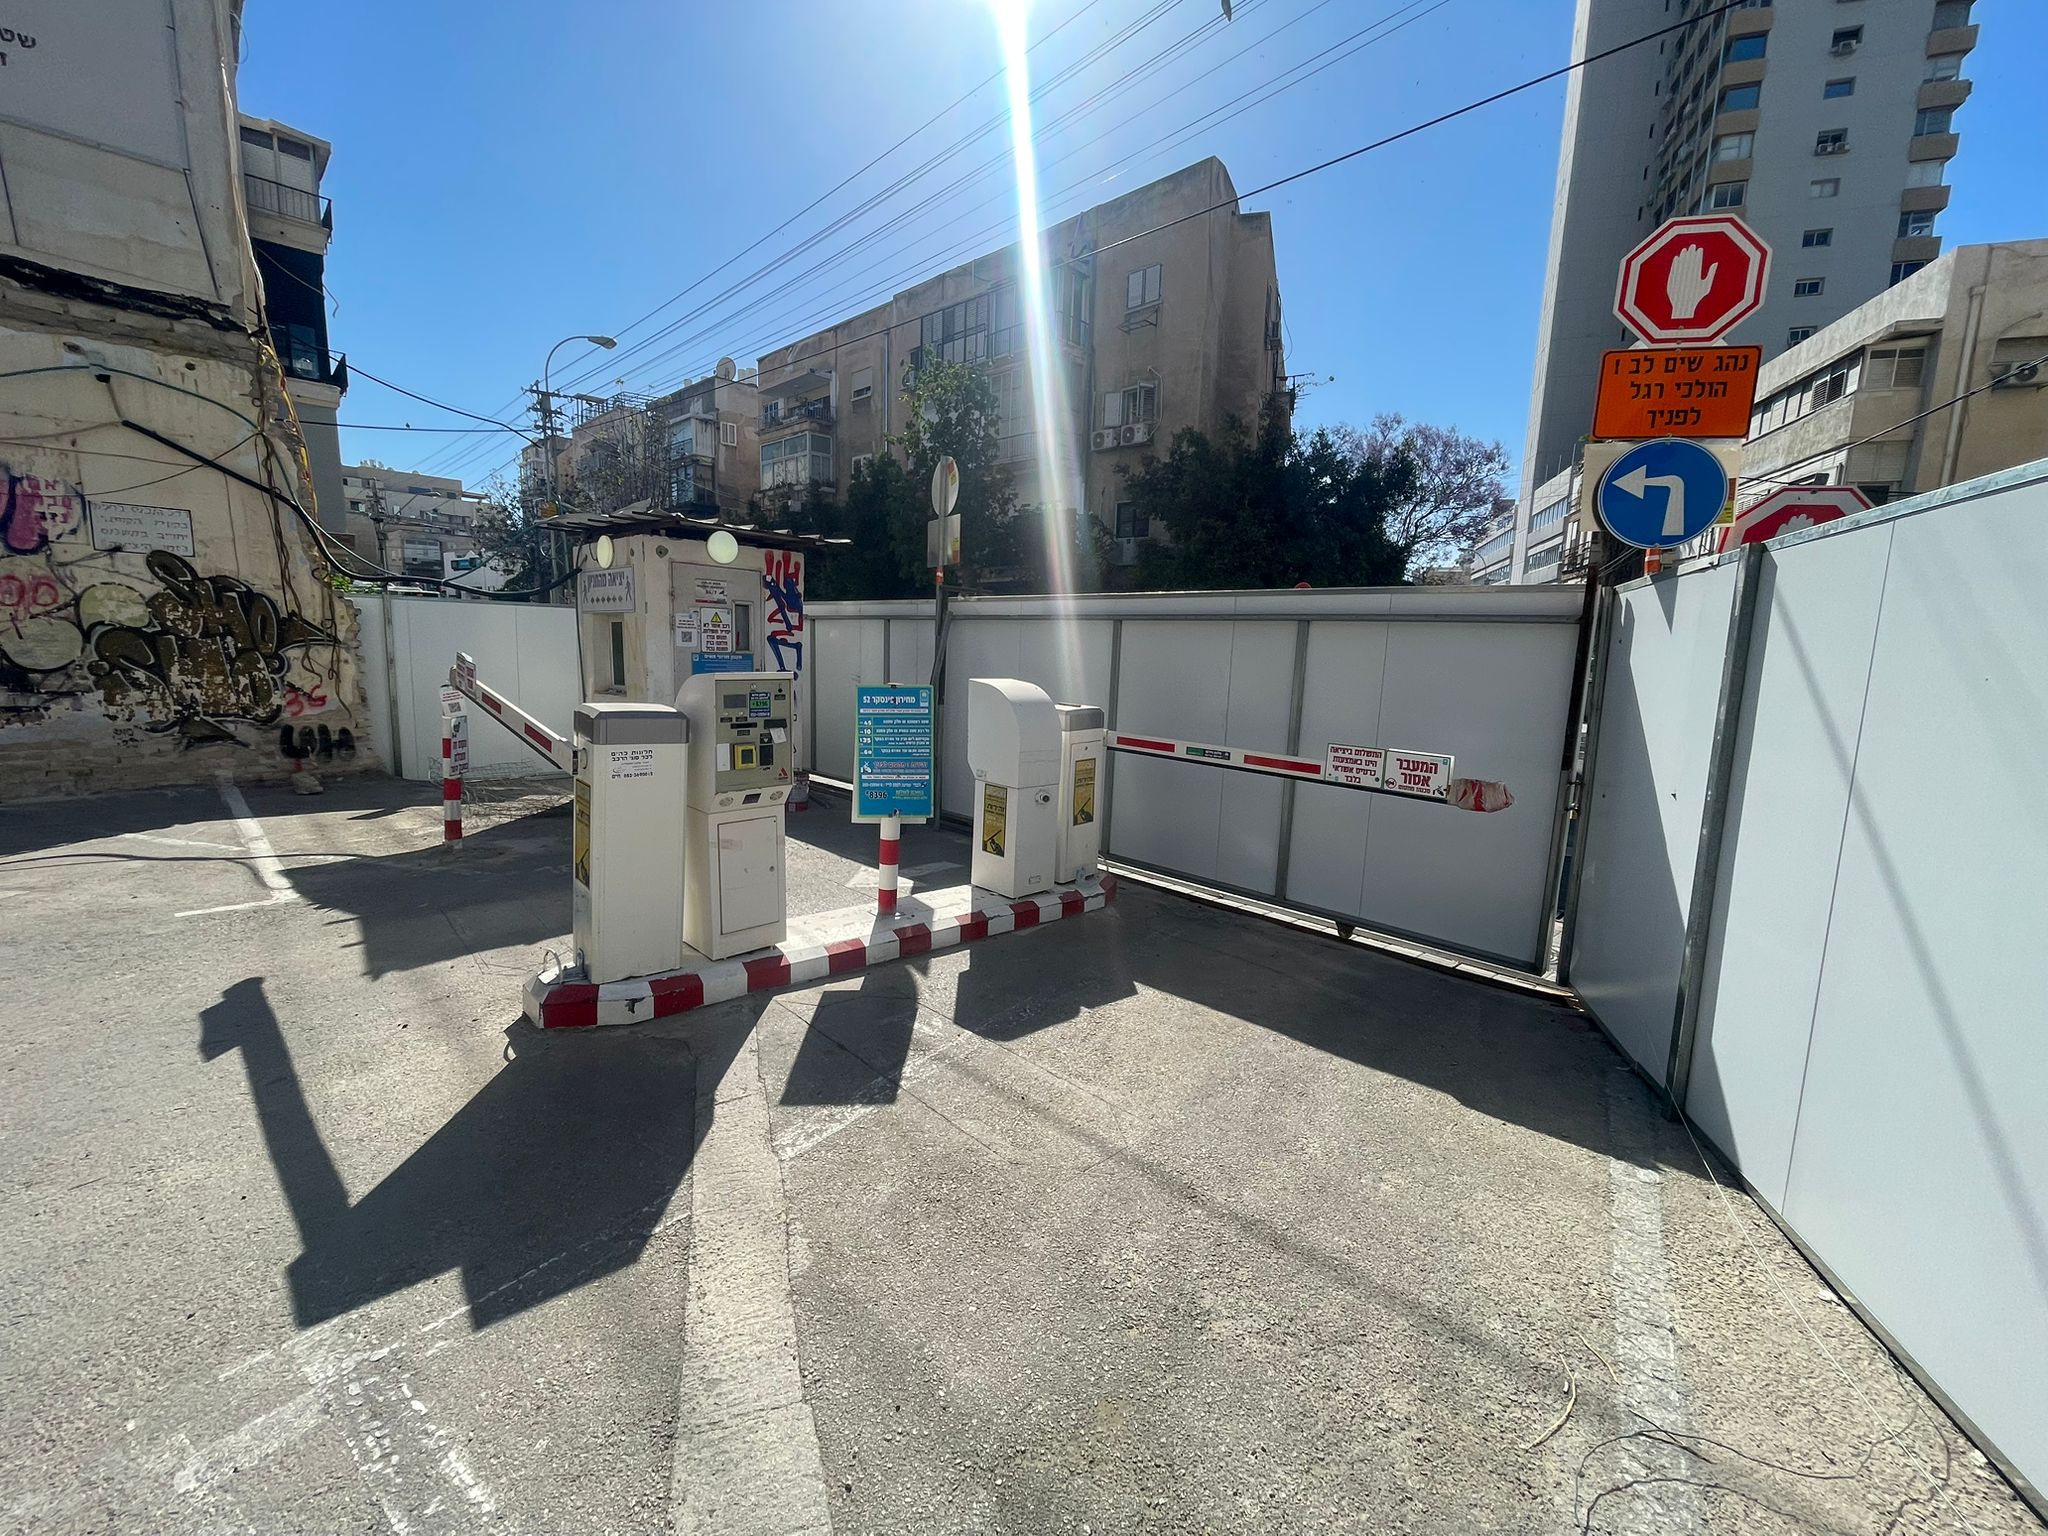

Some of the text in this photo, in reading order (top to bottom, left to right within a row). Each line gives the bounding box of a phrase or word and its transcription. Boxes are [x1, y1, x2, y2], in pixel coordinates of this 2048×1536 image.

[1628, 355, 1654, 374] לב
[1664, 356, 1704, 373] שים
[1713, 354, 1749, 372] נהג
[1630, 379, 1728, 400] הולכי רגל
[1648, 407, 1702, 429] לפניך
[588, 571, 624, 592] יציאה מהחניון
[895, 695, 916, 705] מחירון
[1354, 749, 1382, 759] התשלום
[1396, 758, 1439, 775] המעבר
[1400, 772, 1431, 787] אסור
